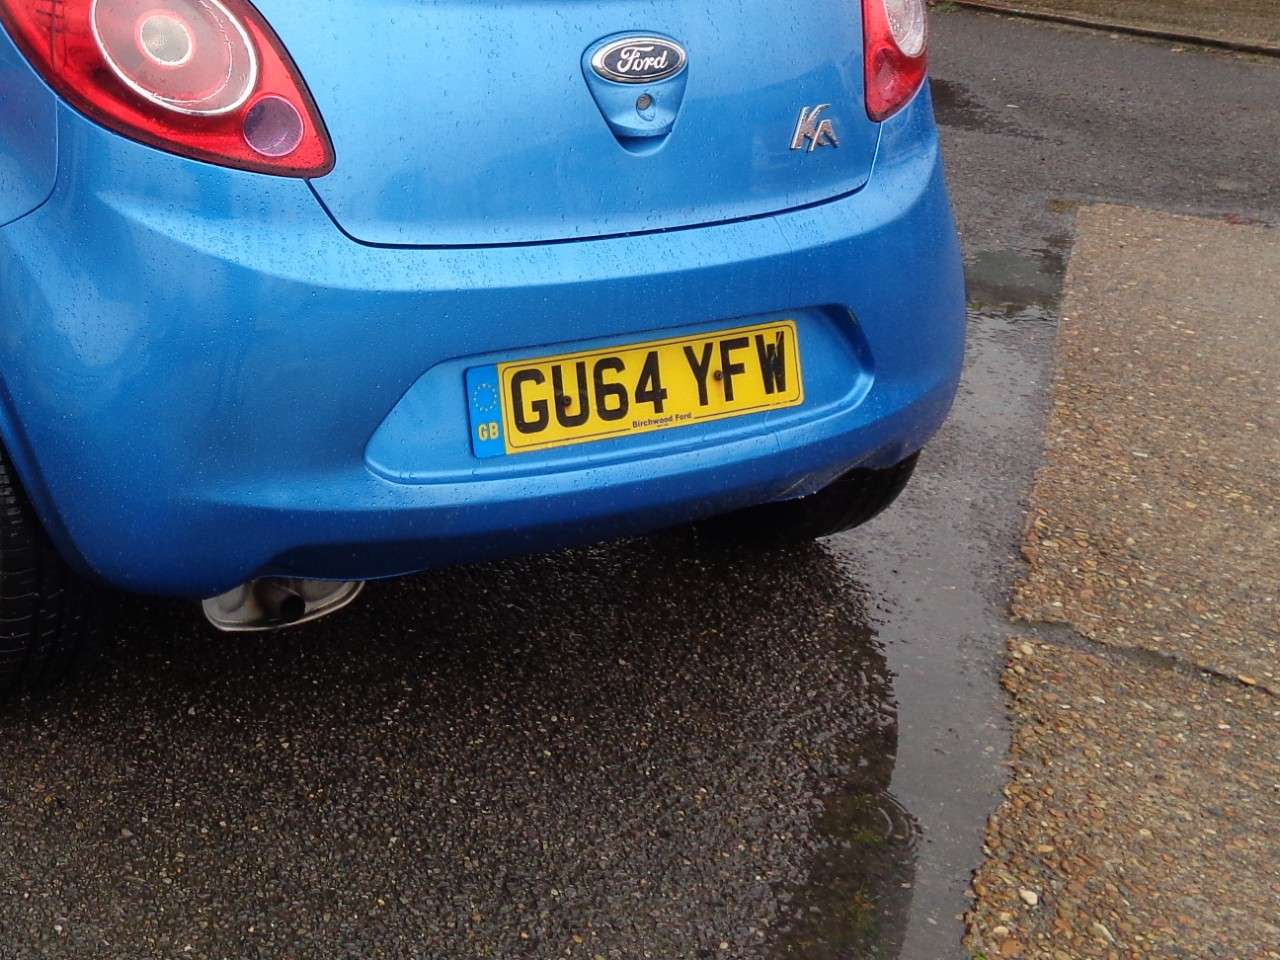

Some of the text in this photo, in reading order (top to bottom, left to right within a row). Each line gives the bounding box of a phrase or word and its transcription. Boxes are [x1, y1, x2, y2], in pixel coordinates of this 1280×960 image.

[616, 46, 668, 73] Ford
[510, 331, 788, 435] GU64 YFW
[632, 411, 692, 428] Birchwood Ford
[477, 423, 499, 442] GB
